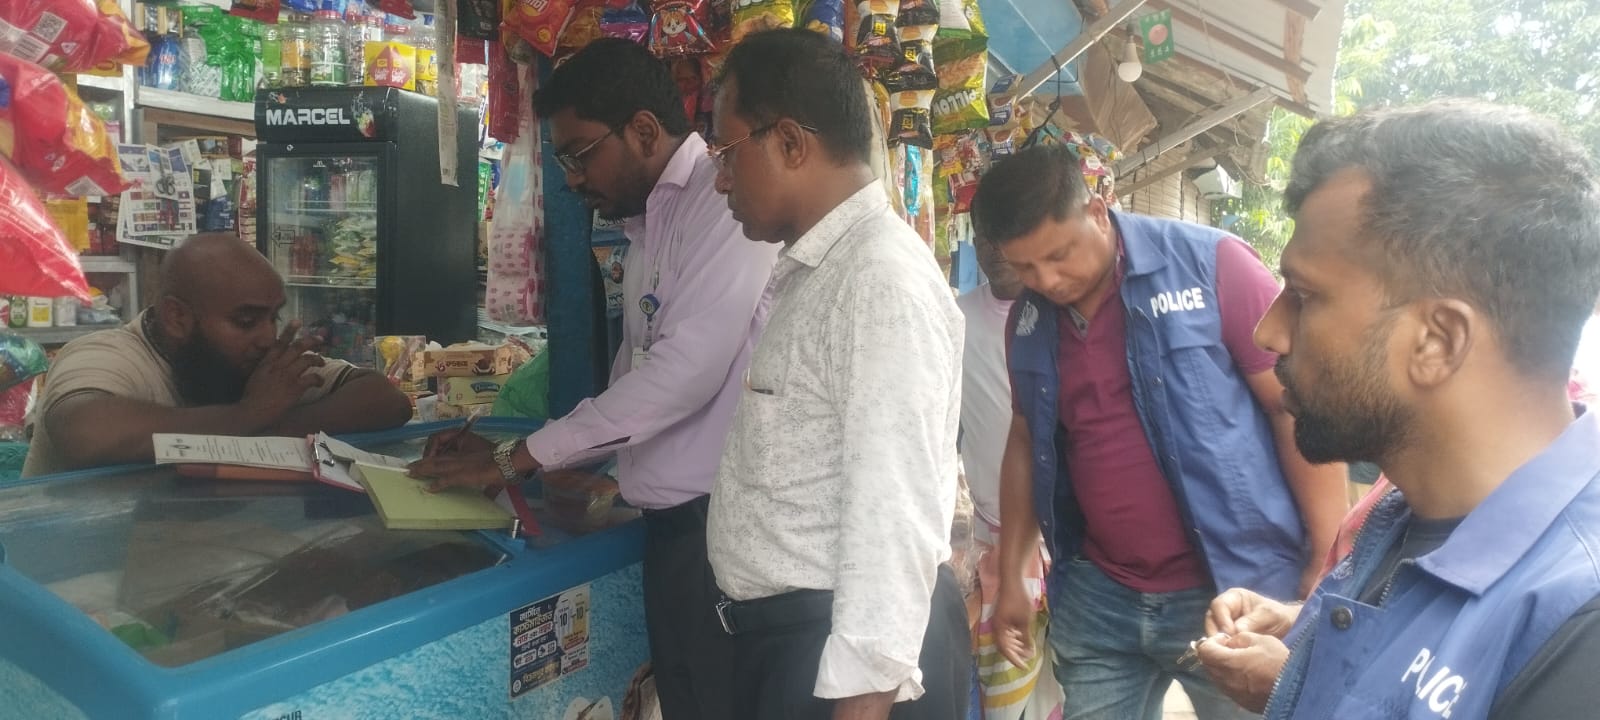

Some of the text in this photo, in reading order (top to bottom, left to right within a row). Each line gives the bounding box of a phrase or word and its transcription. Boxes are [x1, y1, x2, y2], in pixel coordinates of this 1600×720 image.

[265, 107, 351, 126] MARCEL
[1150, 287, 1206, 318] POLICE
[559, 612, 568, 627] 10
